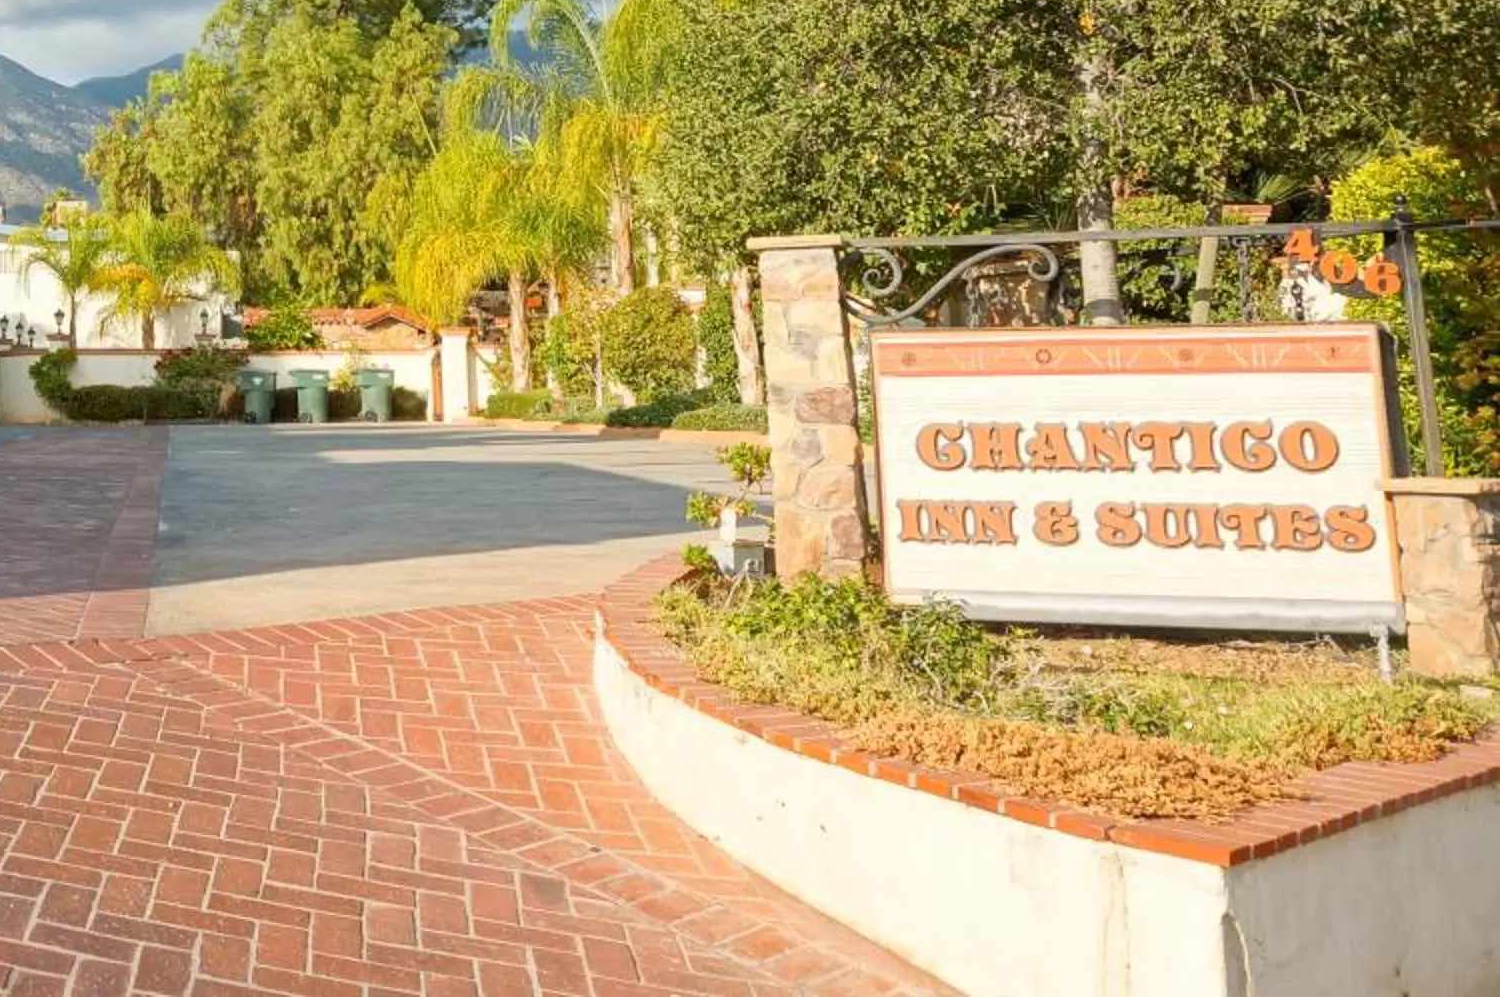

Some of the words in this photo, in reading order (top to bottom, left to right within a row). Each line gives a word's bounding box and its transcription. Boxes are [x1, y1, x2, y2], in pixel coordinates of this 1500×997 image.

[1283, 226, 1404, 297] 406
[915, 419, 1341, 473] CHANTICO
[896, 499, 1018, 546] INN
[1033, 500, 1080, 547] &
[1094, 501, 1377, 552] SUITES
